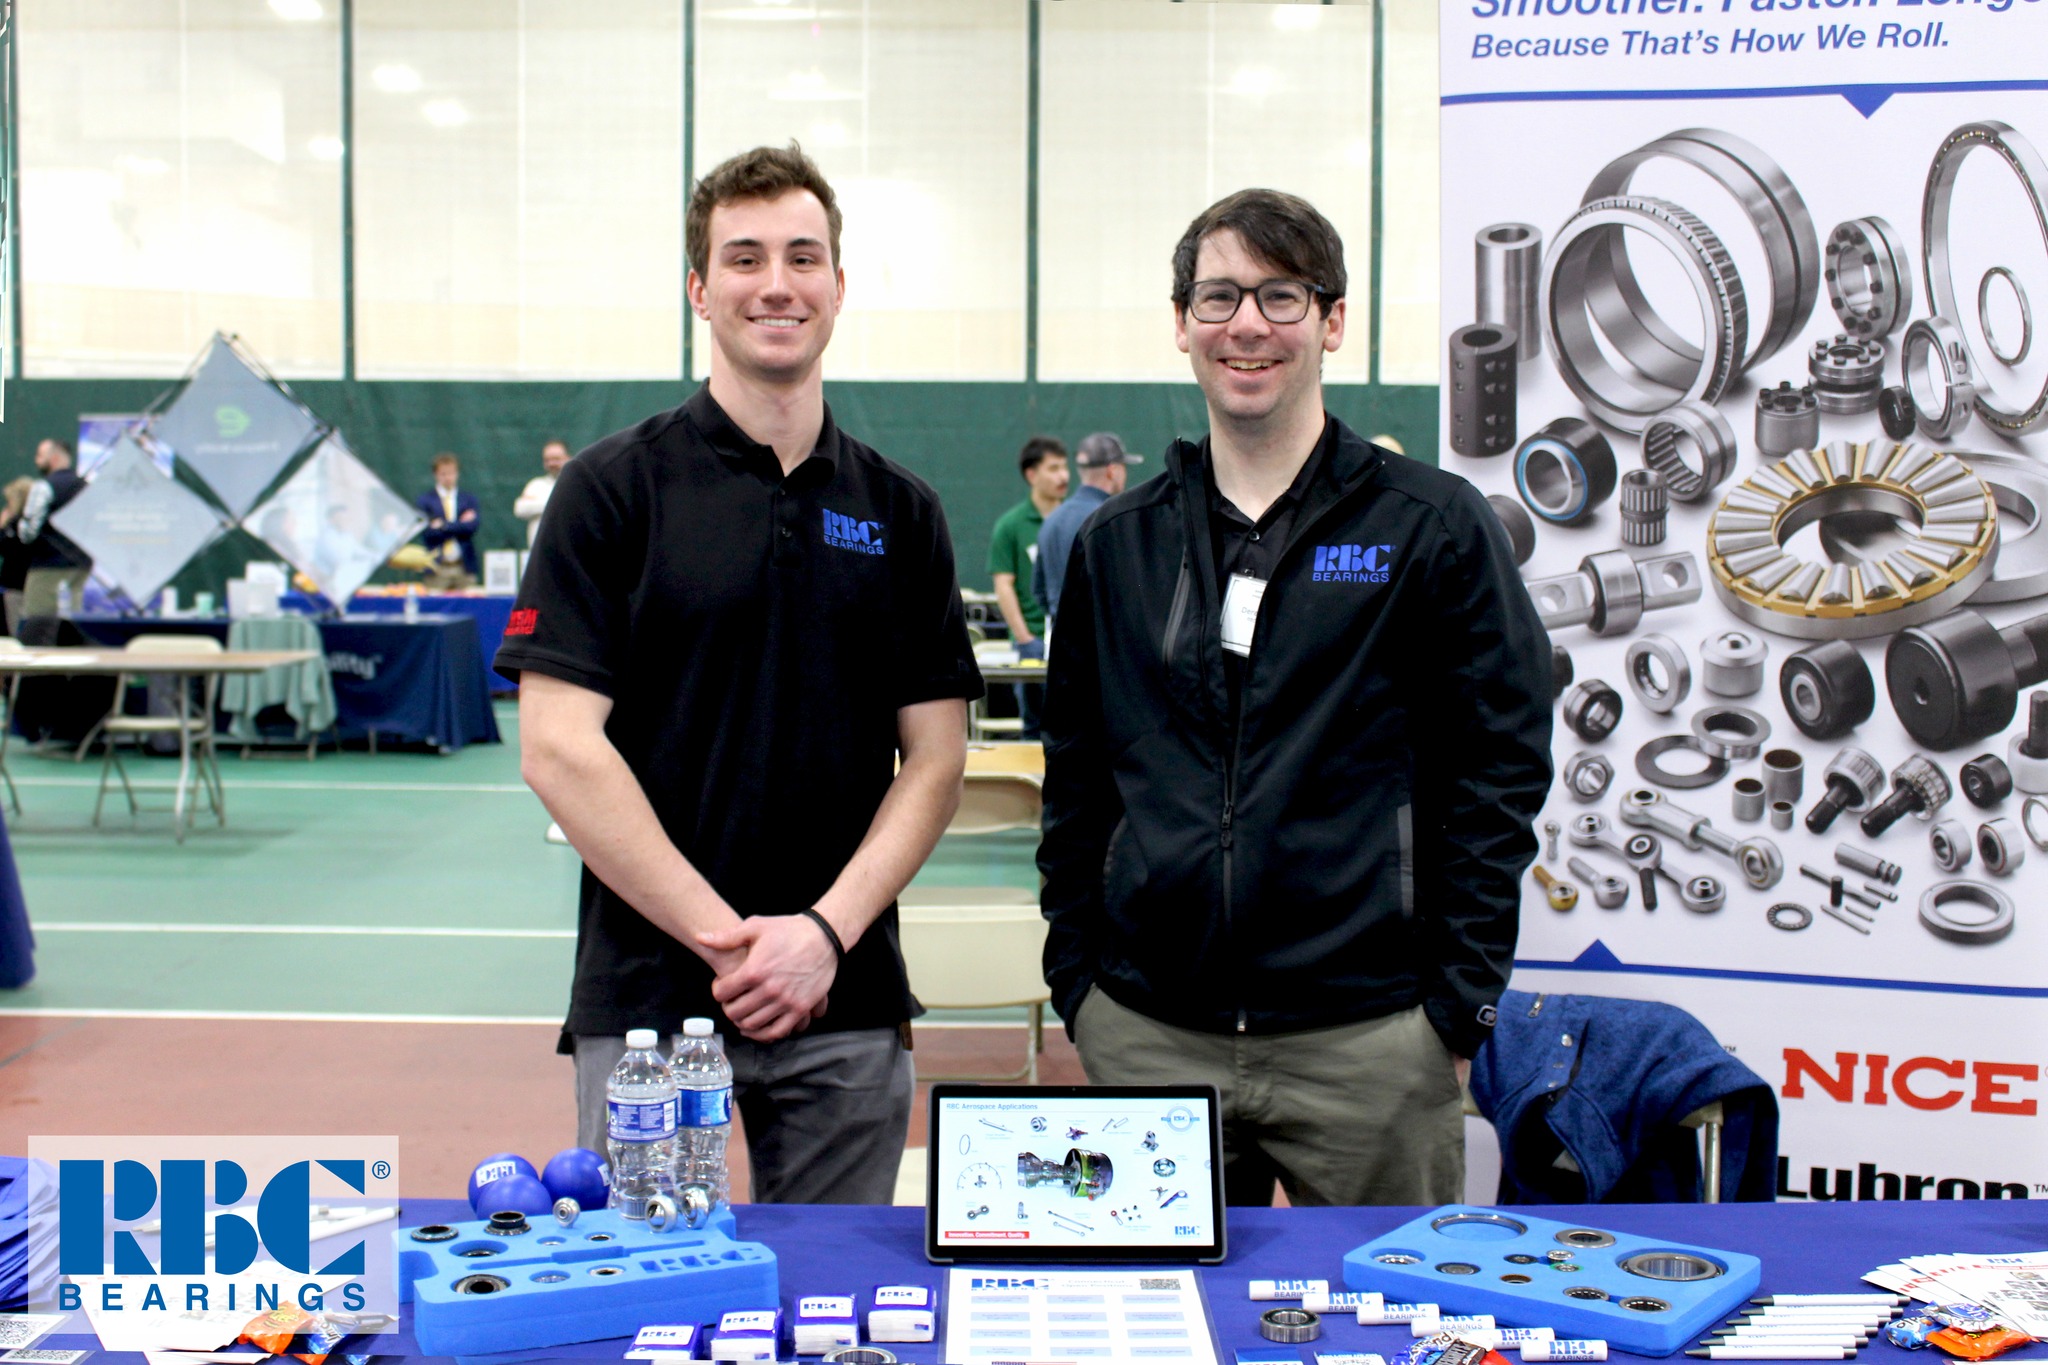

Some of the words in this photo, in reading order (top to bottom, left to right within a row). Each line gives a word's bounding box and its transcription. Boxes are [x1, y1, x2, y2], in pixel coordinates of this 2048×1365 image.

[1472, 33, 1609, 59] Because
[1730, 28, 1805, 54] How
[1817, 23, 1866, 50] We
[1876, 21, 1949, 49] Roll.
[822, 508, 883, 546] RBC
[823, 534, 885, 555] BEARINGS
[1313, 544, 1391, 573] RBC
[1312, 571, 1390, 583] BEARINGS
[1781, 1047, 2040, 1117] NICE
[962, 1103, 996, 1111] Aerospace
[997, 1103, 1038, 1111] Applications
[1777, 1155, 2029, 1202] Lubron
[971, 1278, 1049, 1289] RBC
[1548, 1340, 1595, 1355] RBC
